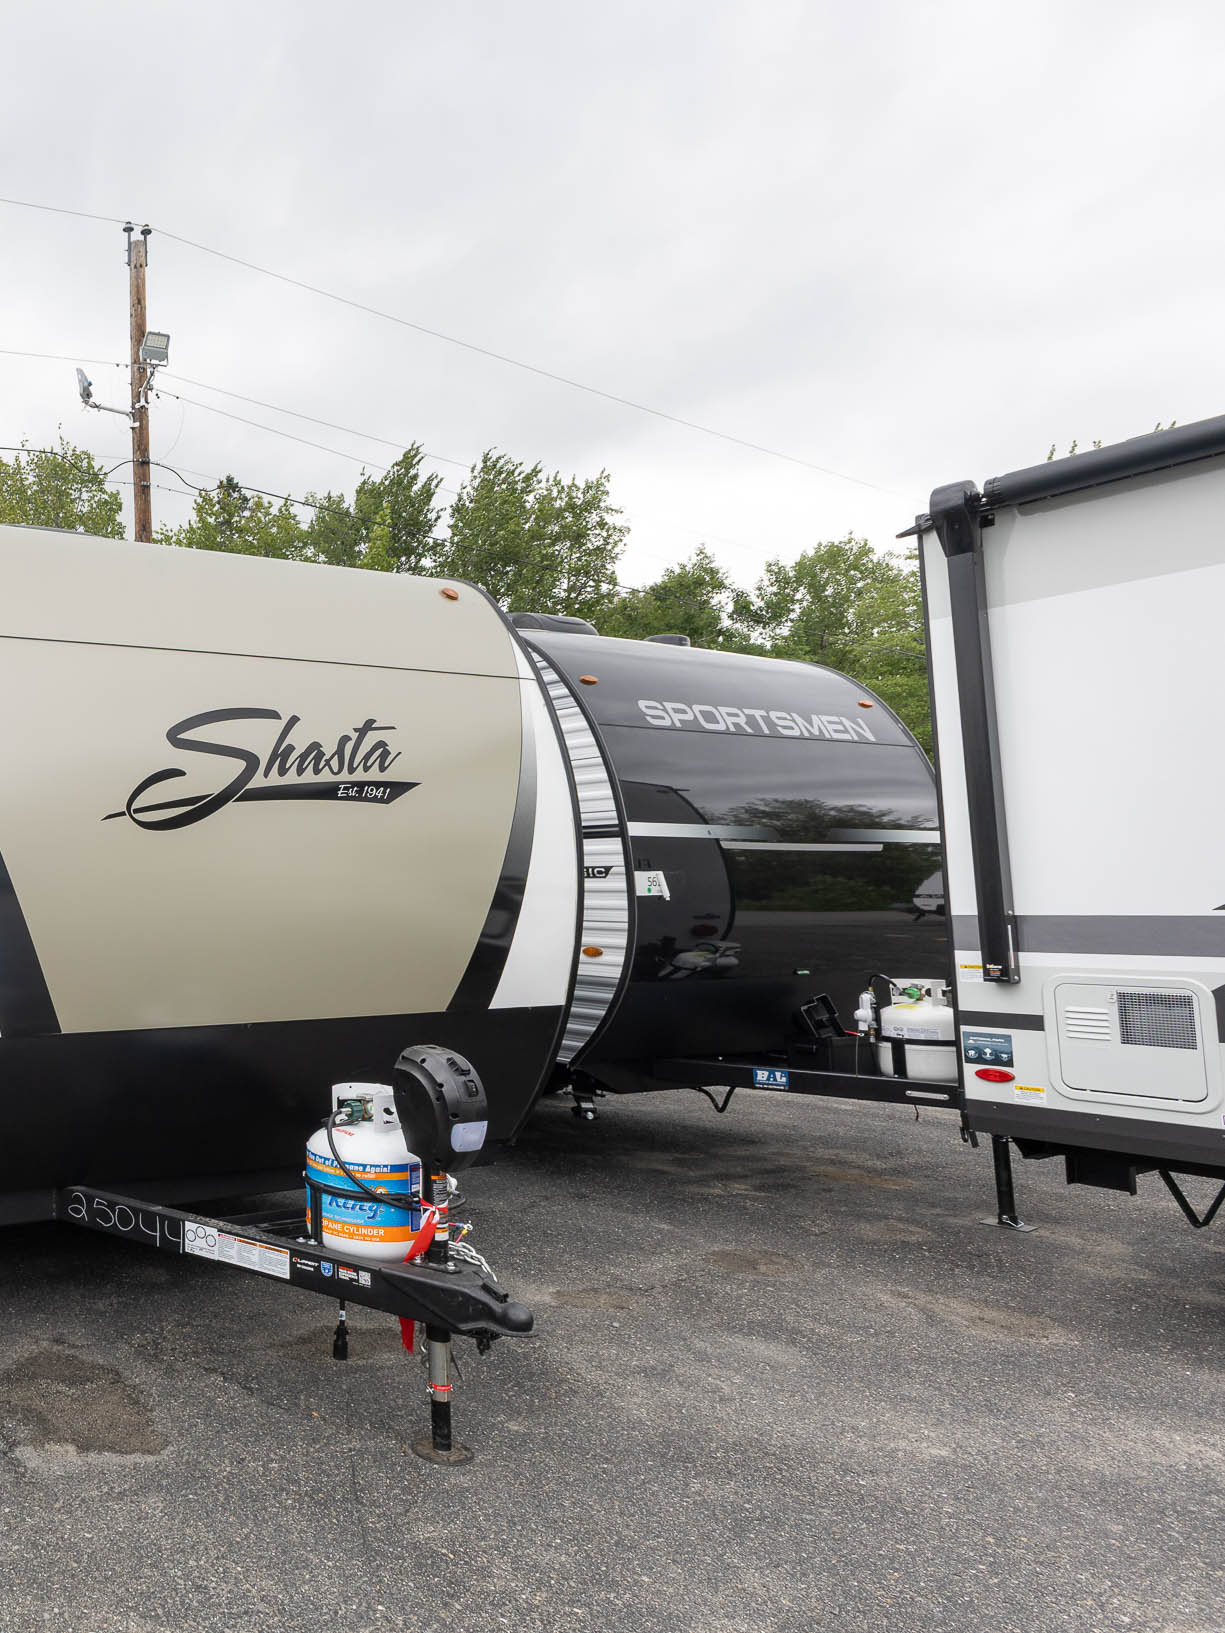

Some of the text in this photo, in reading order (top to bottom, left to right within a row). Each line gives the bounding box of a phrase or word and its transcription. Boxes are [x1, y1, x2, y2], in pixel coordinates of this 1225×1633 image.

[638, 699, 877, 742] SPORTSMEN
[125, 707, 403, 831] Shasta
[337, 784, 391, 800] Est. 1941
[647, 876, 661, 887] 56
[333, 1160, 364, 1172] Pane
[365, 1164, 391, 1173] Again!
[67, 1192, 183, 1254] 25044
[344, 1225, 385, 1236] CYLINDER
